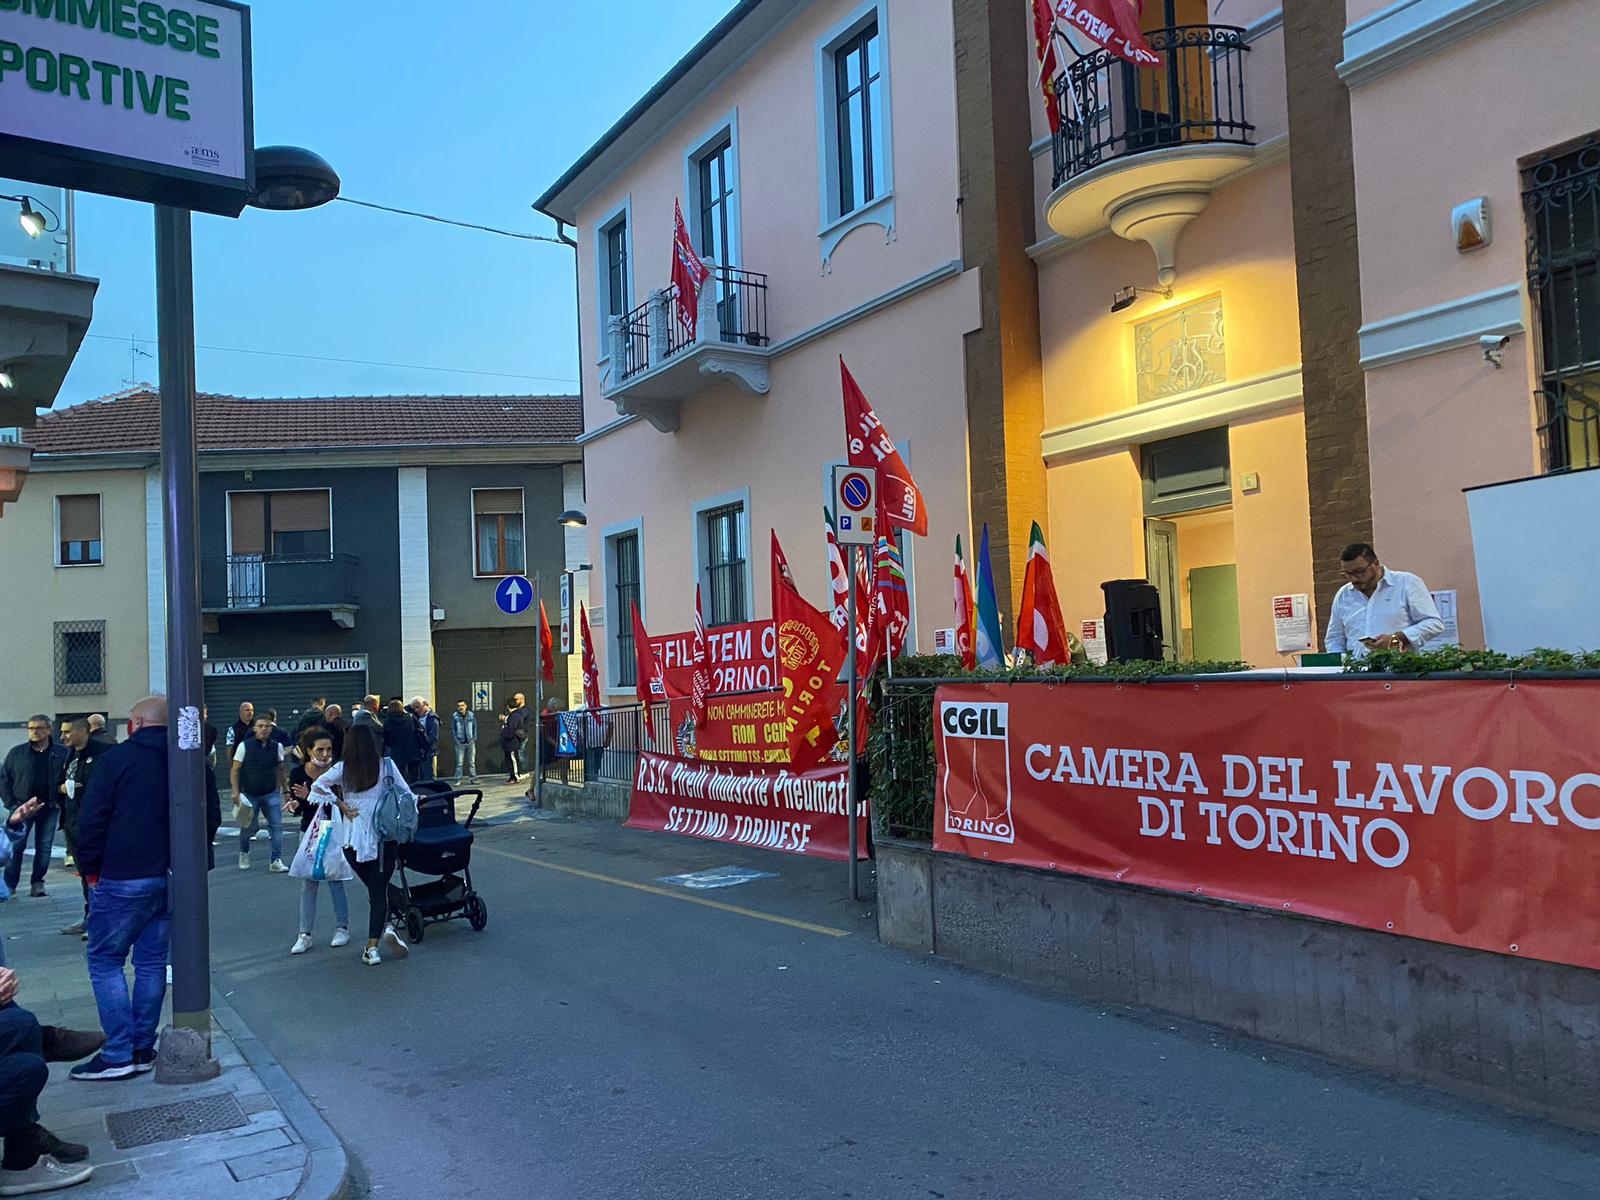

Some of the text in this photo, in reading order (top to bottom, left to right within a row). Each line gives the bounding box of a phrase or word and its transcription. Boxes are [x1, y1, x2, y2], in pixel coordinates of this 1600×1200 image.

[0, 41, 190, 121] PORTIVE
[842, 517, 849, 528] P
[211, 656, 360, 674] LAVASECCO al Pulito
[665, 629, 752, 668] FILTEM
[713, 665, 771, 692] ORINO
[707, 704, 725, 721] NON
[943, 706, 1006, 736] CGIL
[732, 724, 757, 744] FIOM
[637, 758, 669, 794] R.S.U.
[671, 762, 710, 799] Pirelli
[708, 767, 771, 807] Industrie
[1025, 743, 1600, 830] CAMERA DEL LAVORO
[664, 806, 812, 852] SETTIMO TORINESE
[1138, 796, 1410, 868] DI TORINO
